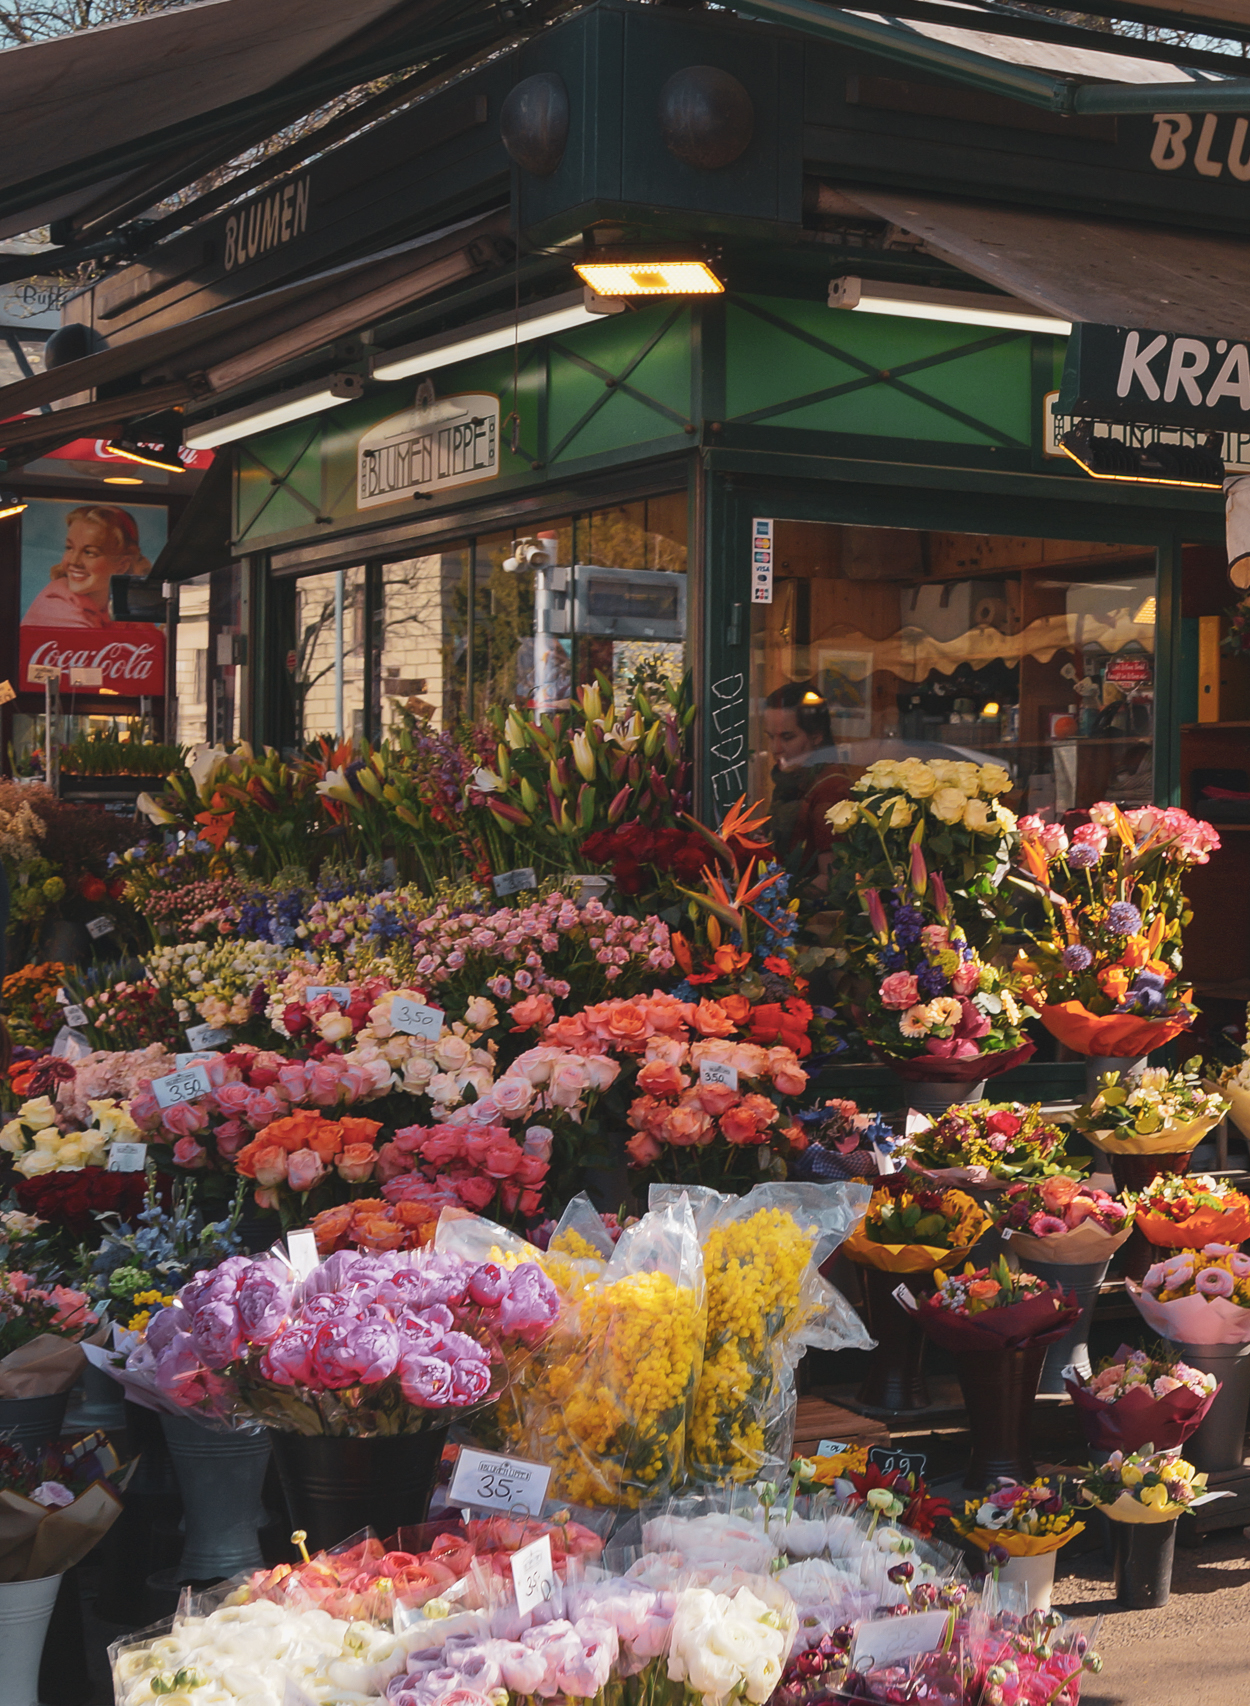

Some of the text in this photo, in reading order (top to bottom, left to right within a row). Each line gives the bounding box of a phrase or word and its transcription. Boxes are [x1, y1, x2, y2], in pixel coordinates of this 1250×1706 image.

[224, 174, 310, 271] BLUMEN
[368, 417, 487, 496] BLUMEN LIPPE
[29, 640, 156, 680] Coca-Cola
[398, 1006, 434, 1026] 3,50
[477, 1475, 523, 1502] 35,-
